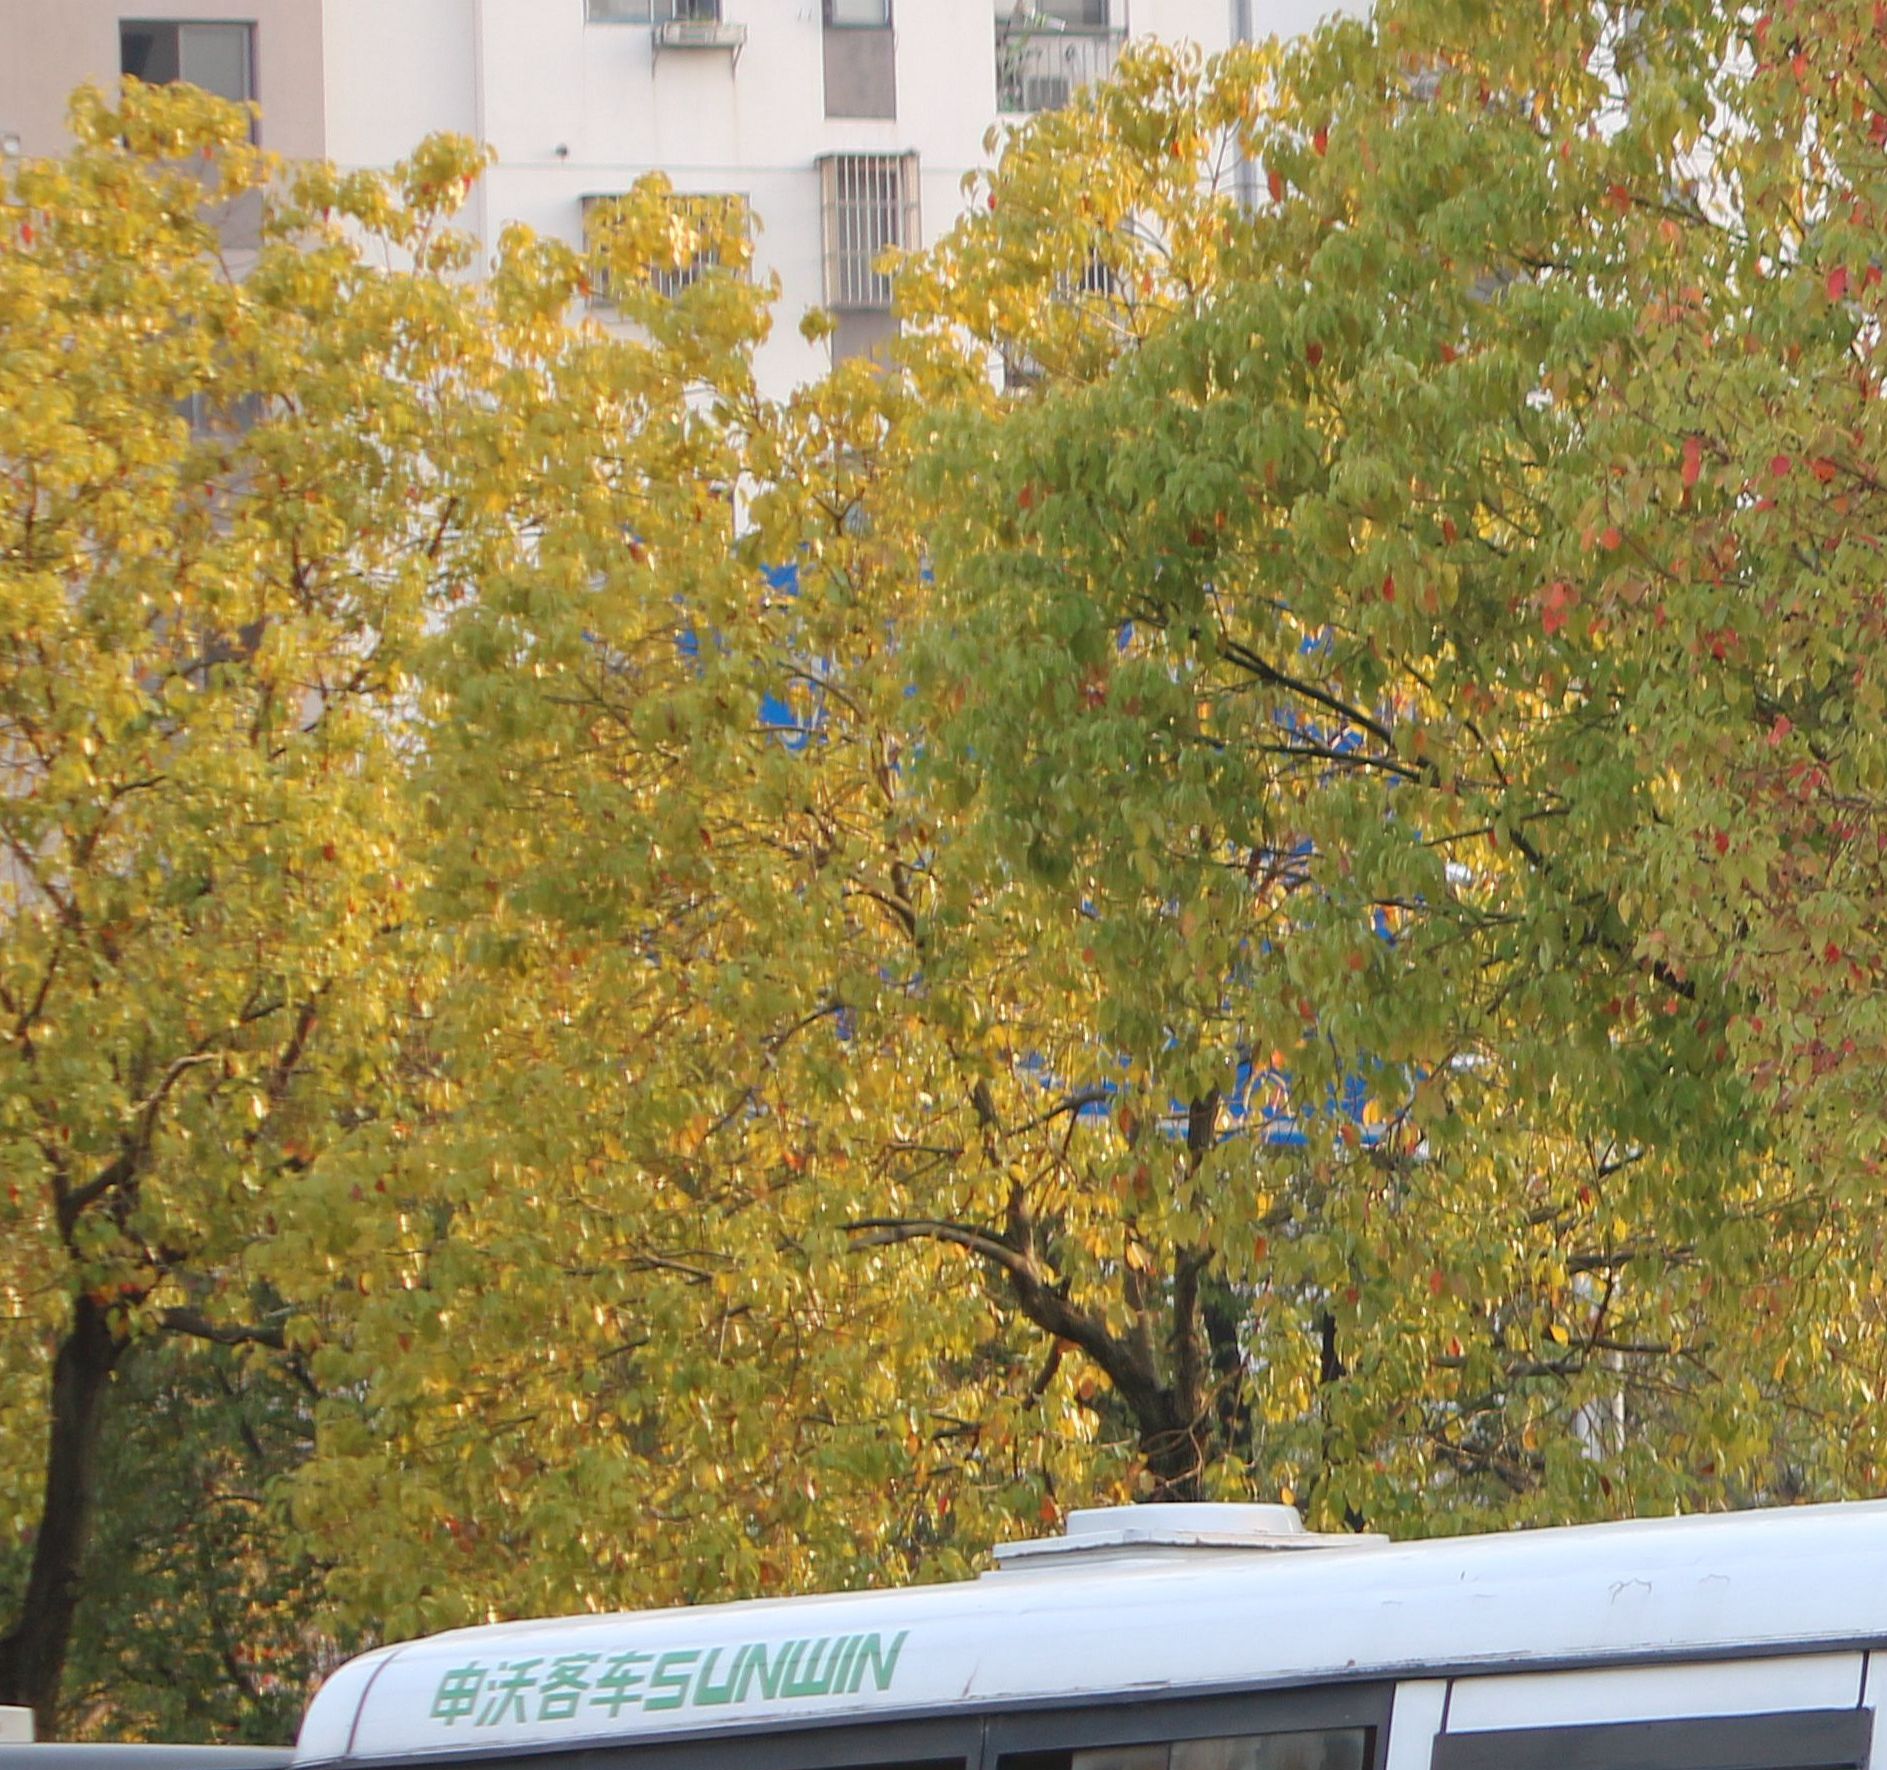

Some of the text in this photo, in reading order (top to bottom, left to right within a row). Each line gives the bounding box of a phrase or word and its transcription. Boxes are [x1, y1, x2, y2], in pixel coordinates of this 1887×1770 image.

[430, 1630, 909, 1727] 申沃客车 SUNWIN
